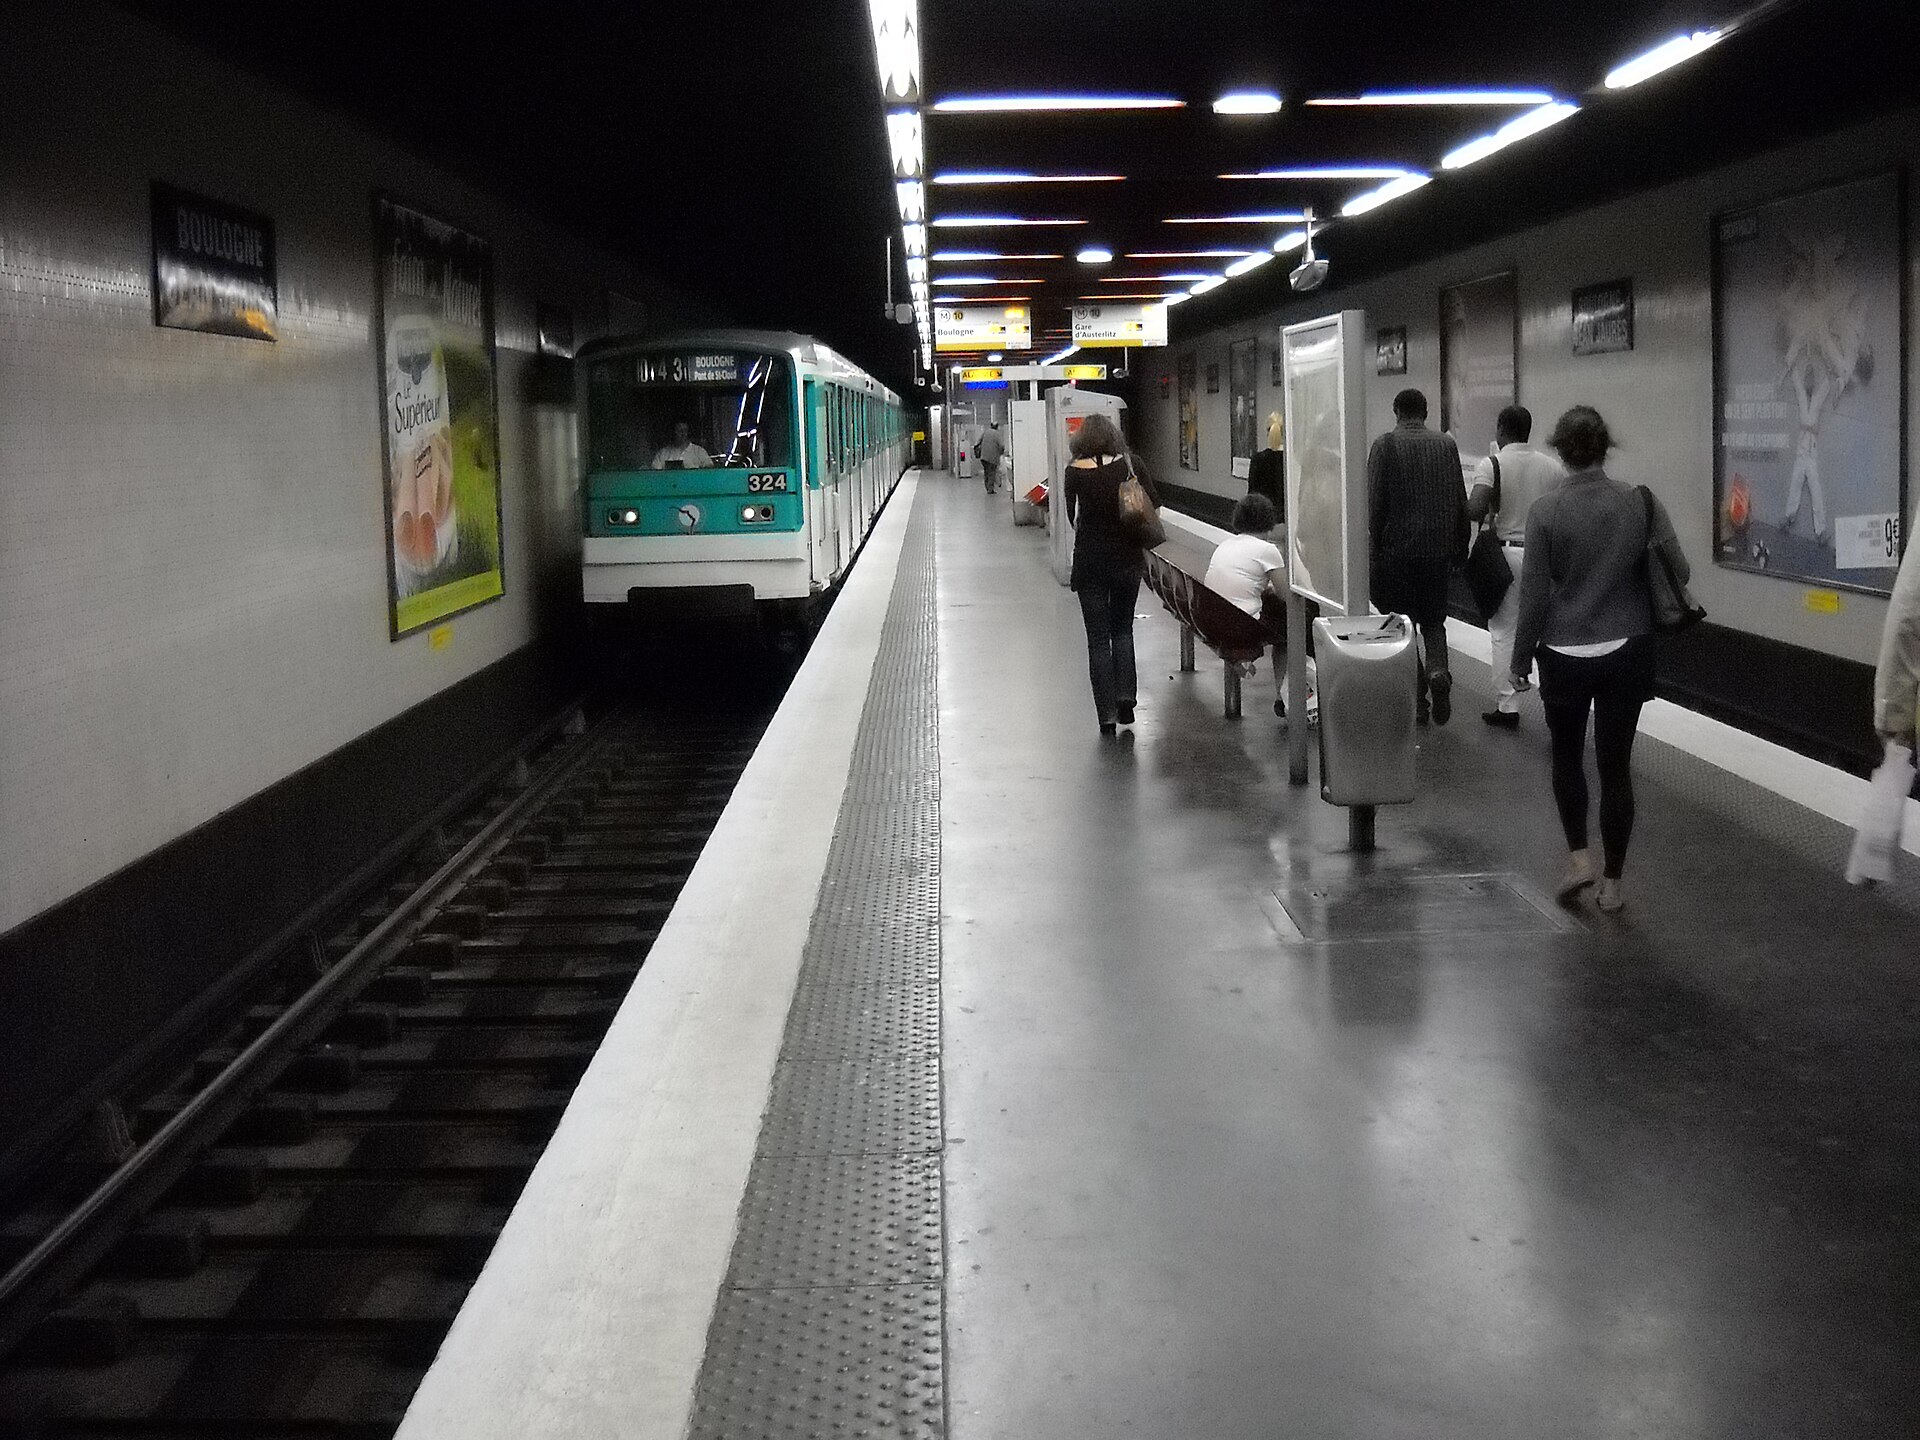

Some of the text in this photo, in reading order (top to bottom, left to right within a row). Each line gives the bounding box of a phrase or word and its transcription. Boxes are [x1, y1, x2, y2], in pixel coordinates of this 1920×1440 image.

[177, 206, 264, 267] BOULOGNE
[937, 329, 975, 337] Boulogne
[1075, 323, 1092, 331] Gare
[1075, 331, 1117, 339] d'Austerlitz
[695, 355, 735, 368] BOULOGNE
[394, 391, 441, 436] Supérieur
[749, 475, 786, 491] 324
